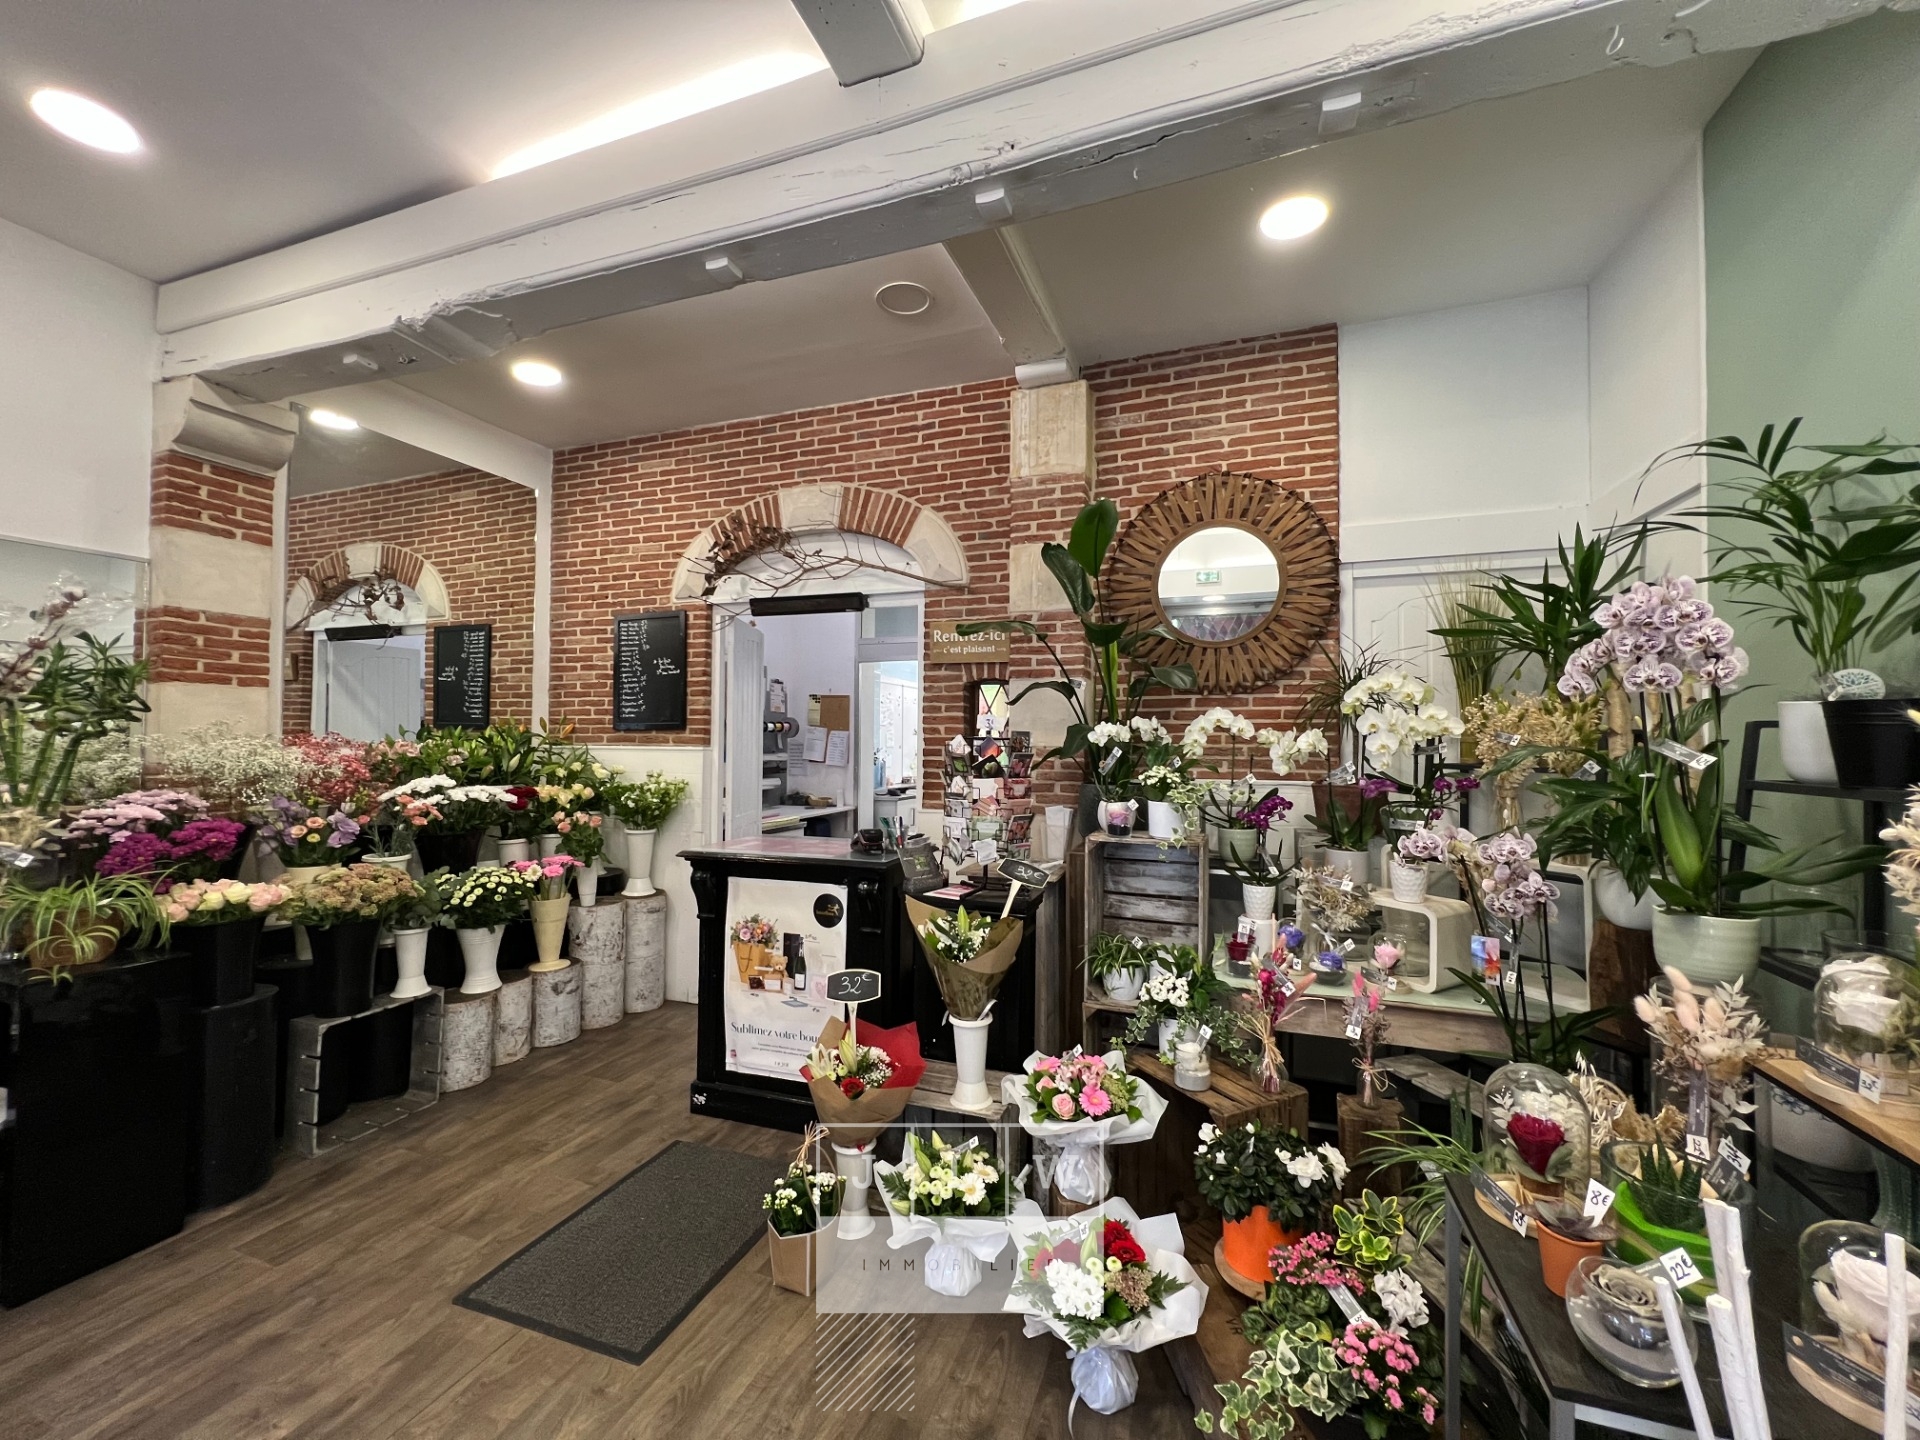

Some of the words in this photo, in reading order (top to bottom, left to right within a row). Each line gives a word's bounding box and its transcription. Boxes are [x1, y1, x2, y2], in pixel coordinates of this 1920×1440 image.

[943, 645, 961, 654] c'est
[963, 644, 995, 655] plaisant
[838, 972, 873, 995] 32€
[731, 1021, 773, 1037] Sublimez
[774, 1030, 798, 1040] votre
[799, 1029, 819, 1043] bou
[1590, 1190, 1610, 1207] 8€
[1669, 1254, 1694, 1281] 22€
